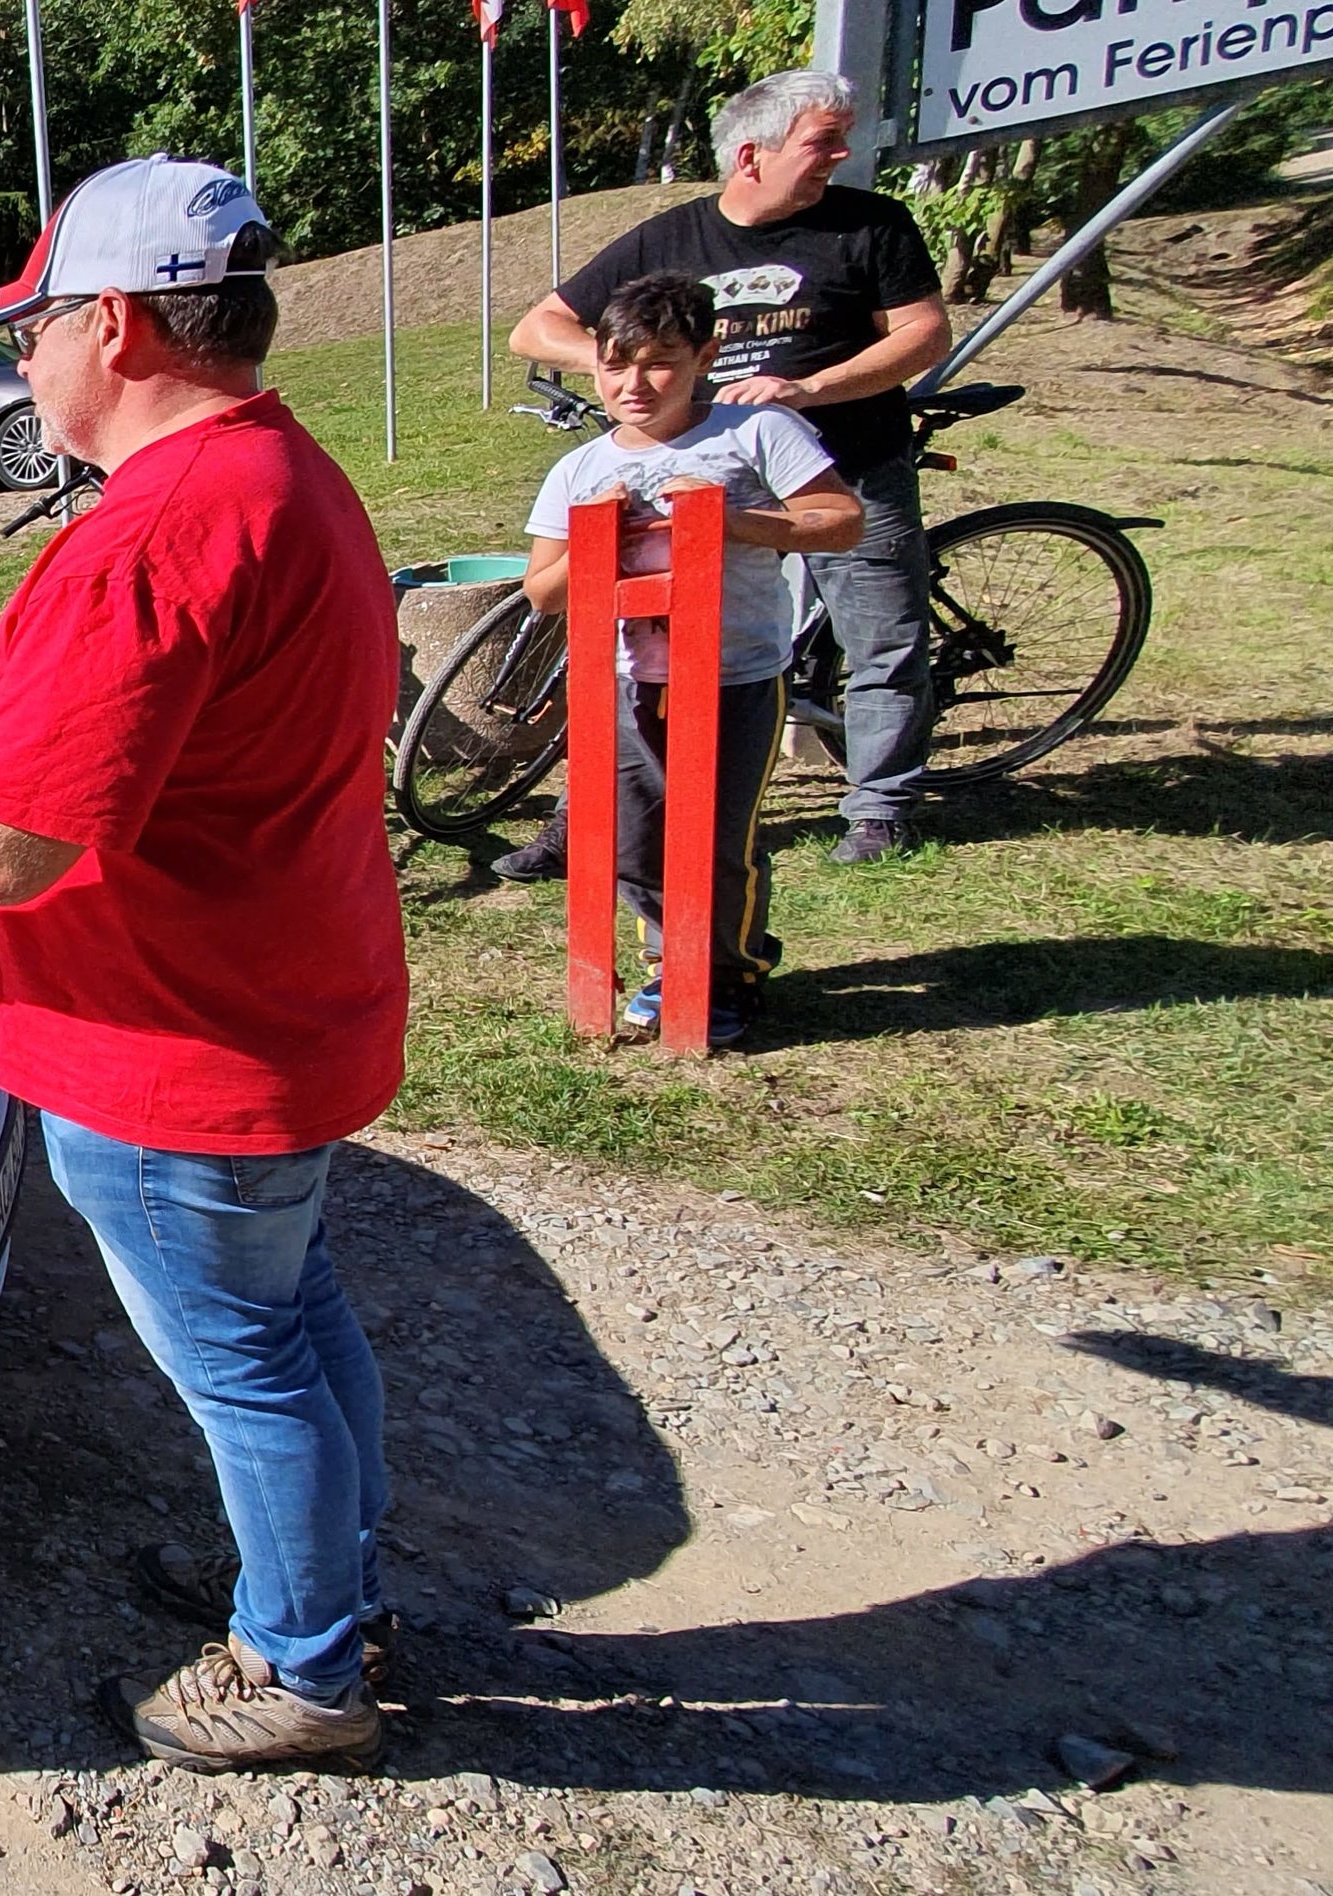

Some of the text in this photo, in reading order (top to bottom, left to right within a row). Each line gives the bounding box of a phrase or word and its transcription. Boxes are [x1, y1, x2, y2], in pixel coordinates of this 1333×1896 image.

[949, 63, 1079, 119] vom
[1104, 5, 1333, 88] Ferienp
[756, 308, 812, 336] KING
[751, 350, 771, 361] REA
